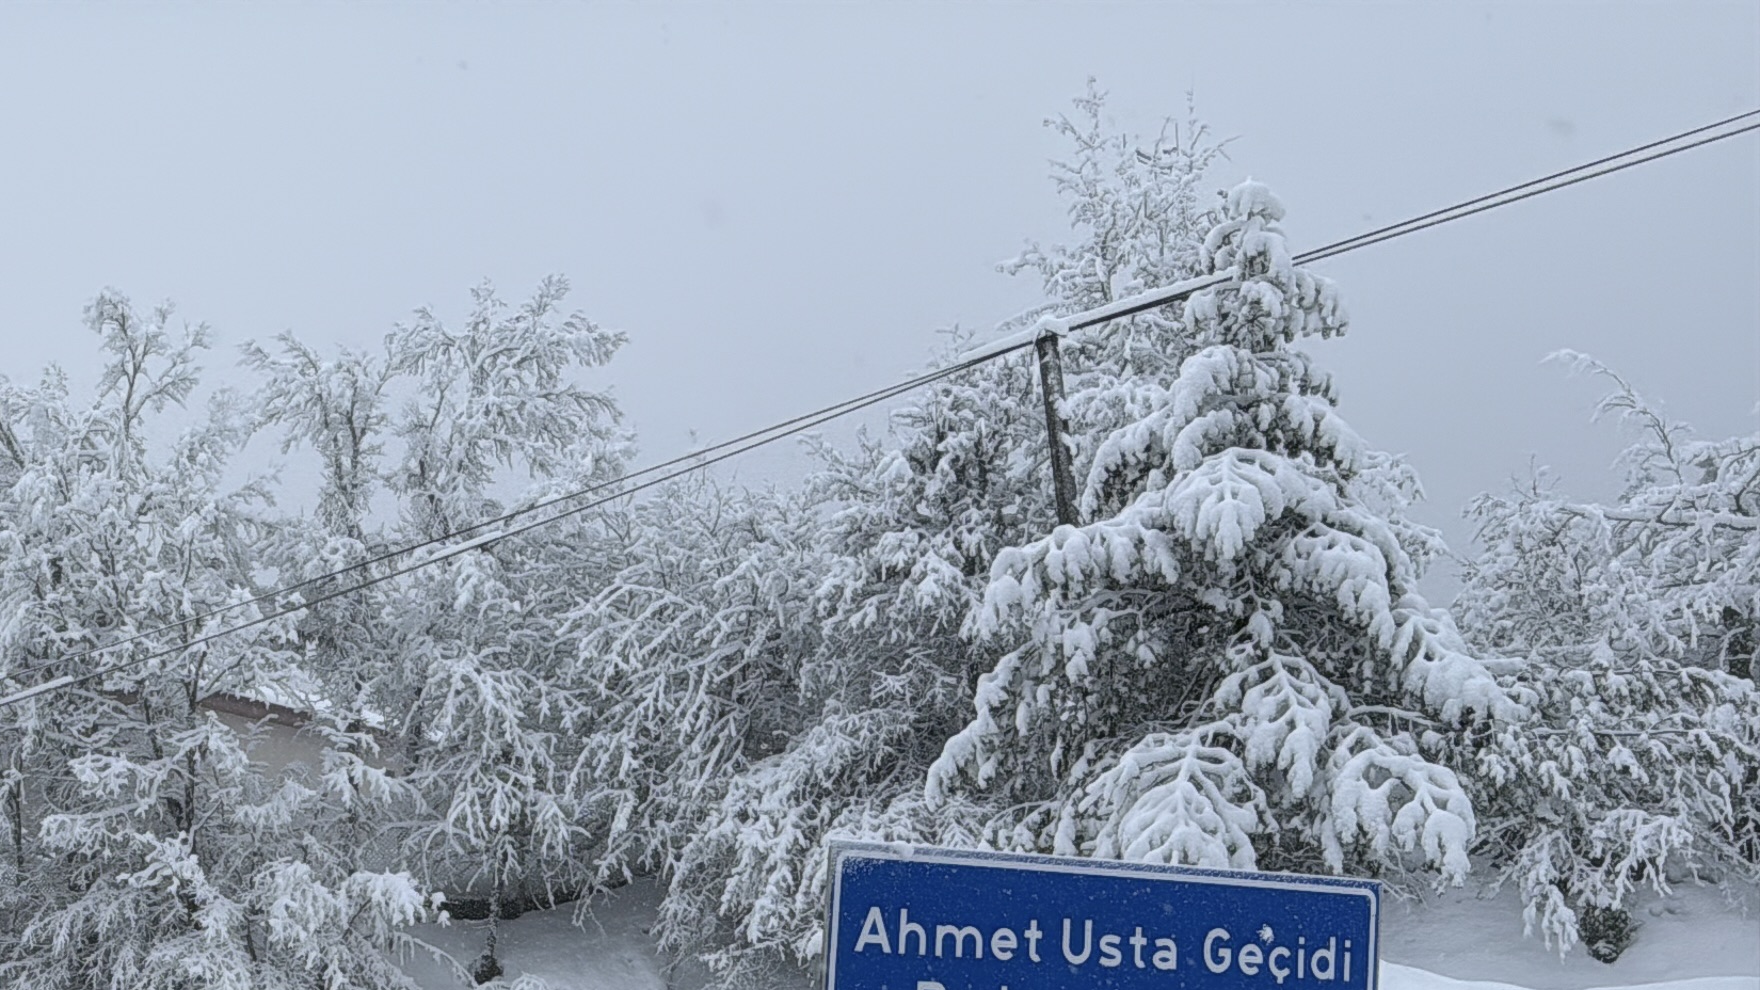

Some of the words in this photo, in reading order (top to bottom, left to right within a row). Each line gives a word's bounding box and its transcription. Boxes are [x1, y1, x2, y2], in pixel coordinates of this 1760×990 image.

[854, 906, 1043, 963] Ahmet
[1062, 917, 1177, 971] Usta
[1203, 926, 1352, 984] Geçidi
